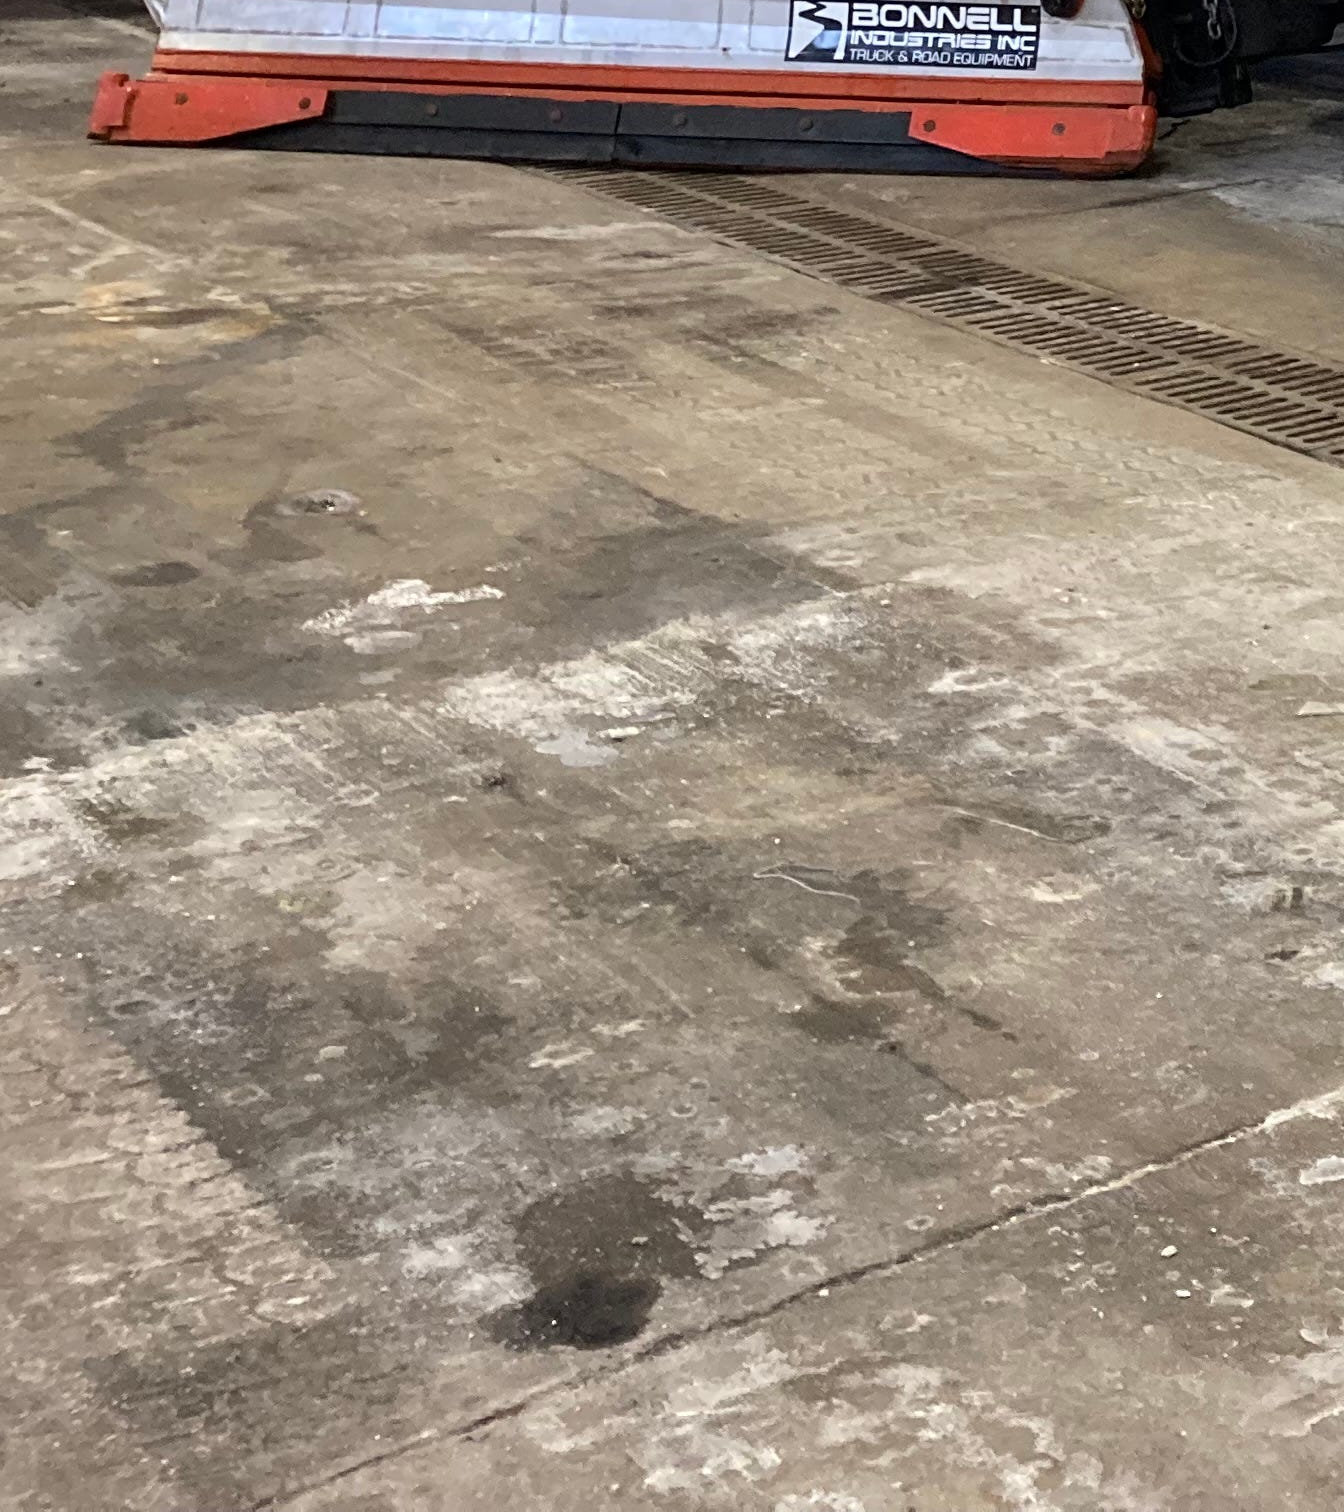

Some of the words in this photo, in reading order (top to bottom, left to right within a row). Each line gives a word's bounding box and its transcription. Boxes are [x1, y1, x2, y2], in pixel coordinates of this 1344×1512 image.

[852, 2, 1038, 33] BONNELL
[850, 29, 993, 50] INDUSTRIES
[997, 34, 1036, 51] INC
[850, 48, 895, 62] TRUCK
[897, 51, 909, 63] &
[911, 51, 950, 65] ROAD
[953, 52, 1035, 67] EQUIPMENT
